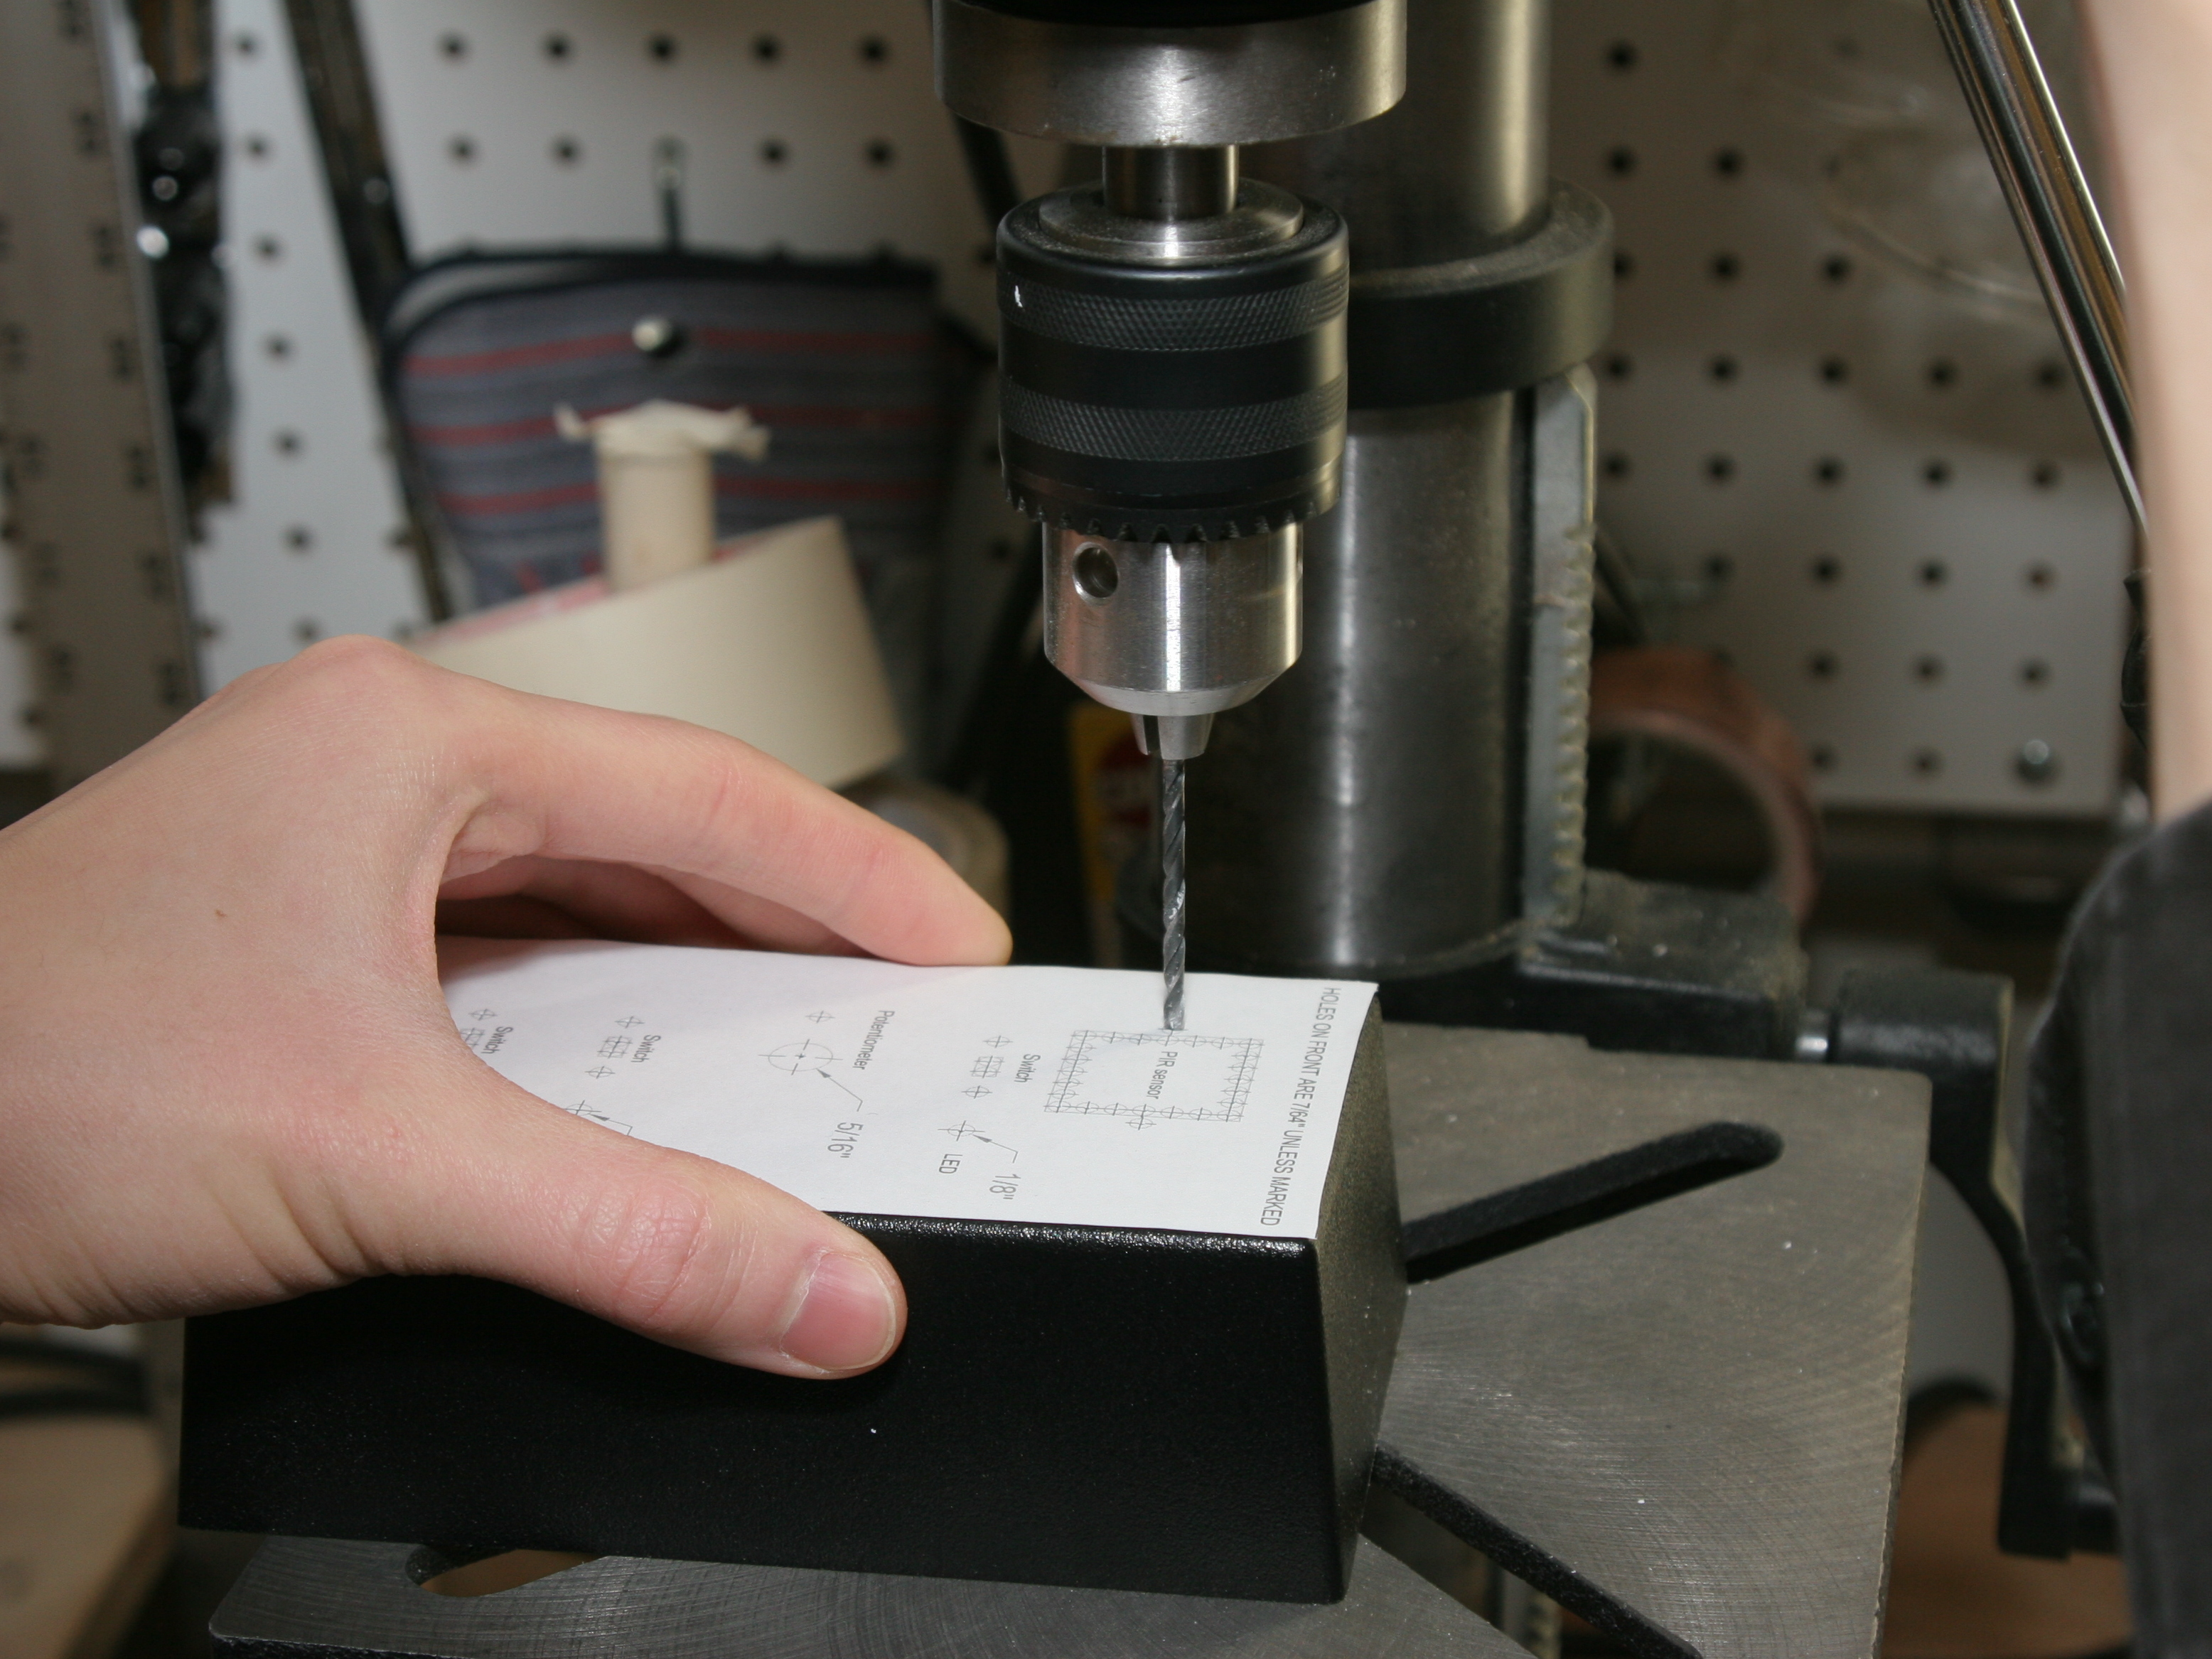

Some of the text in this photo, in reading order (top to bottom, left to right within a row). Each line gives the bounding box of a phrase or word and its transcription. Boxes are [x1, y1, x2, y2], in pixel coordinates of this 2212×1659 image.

[481, 1026, 513, 1054] Switch
[630, 1034, 661, 1063] Switch
[852, 1010, 896, 1070] Potentiometer
[1014, 1053, 1041, 1083] Switch
[1146, 1051, 1179, 1100] PIR sensor
[1260, 987, 1342, 1226] HOLES ON FRONT ARE 7/64" UNLESS MARKED
[827, 1122, 864, 1159] 5/16"
[938, 1154, 963, 1174] LED
[989, 1174, 1021, 1200] 1/8"
